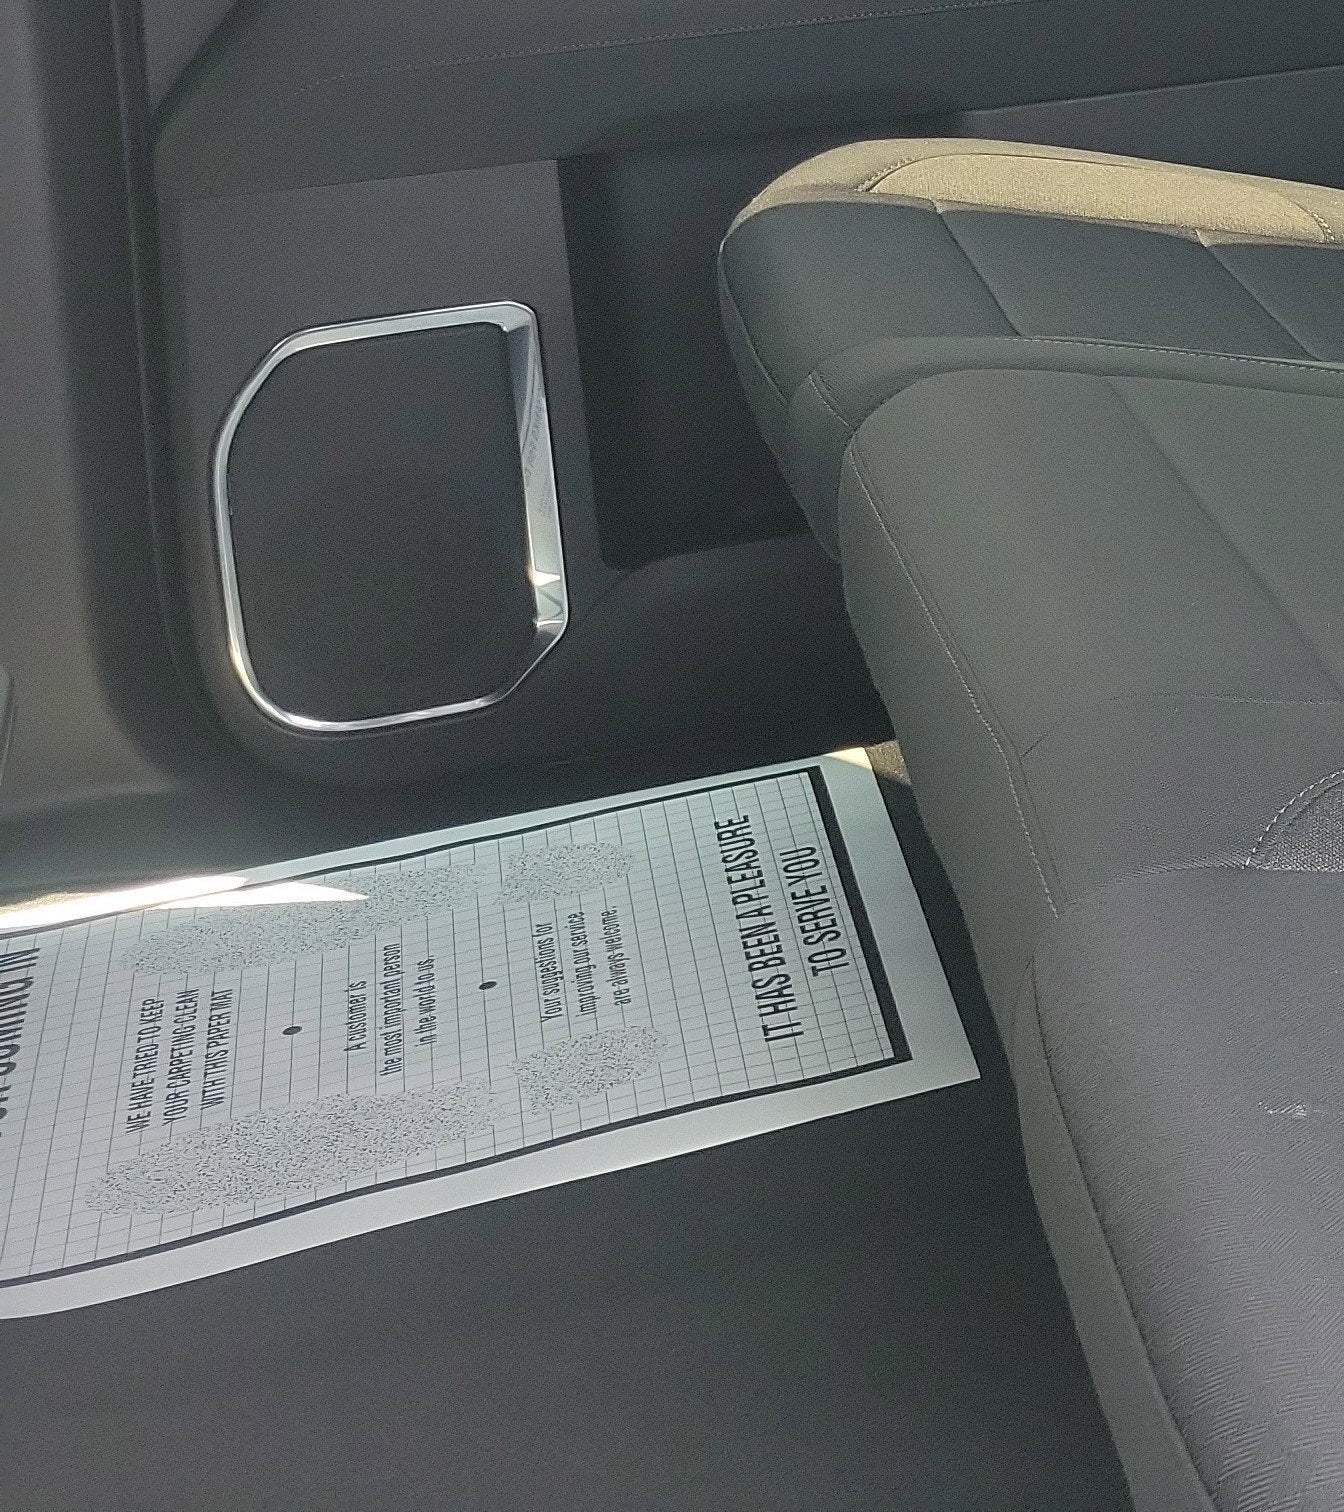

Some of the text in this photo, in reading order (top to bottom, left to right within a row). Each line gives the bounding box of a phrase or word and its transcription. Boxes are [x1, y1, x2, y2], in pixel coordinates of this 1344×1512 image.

[714, 814, 804, 1042] IT HAS BEEN A PLEASURE
[779, 846, 849, 977] TO SERVE YOU
[378, 943, 407, 1076] the most important person
[412, 984, 436, 1015] world
[414, 972, 435, 985] to
[532, 922, 564, 1022] Your suggestions for
[564, 911, 601, 1017] improving our service
[606, 952, 631, 987] always
[613, 988, 631, 1005] are
[126, 998, 164, 1133] WE HAVE TRIED TO KEEP
[162, 989, 199, 1126] YOUR CARPETING CLEAN
[200, 988, 233, 1110] WITH THIS PAPER MAT
[343, 980, 367, 1051] A customer is
[413, 1015, 437, 1034] the
[414, 1034, 437, 1047] in
